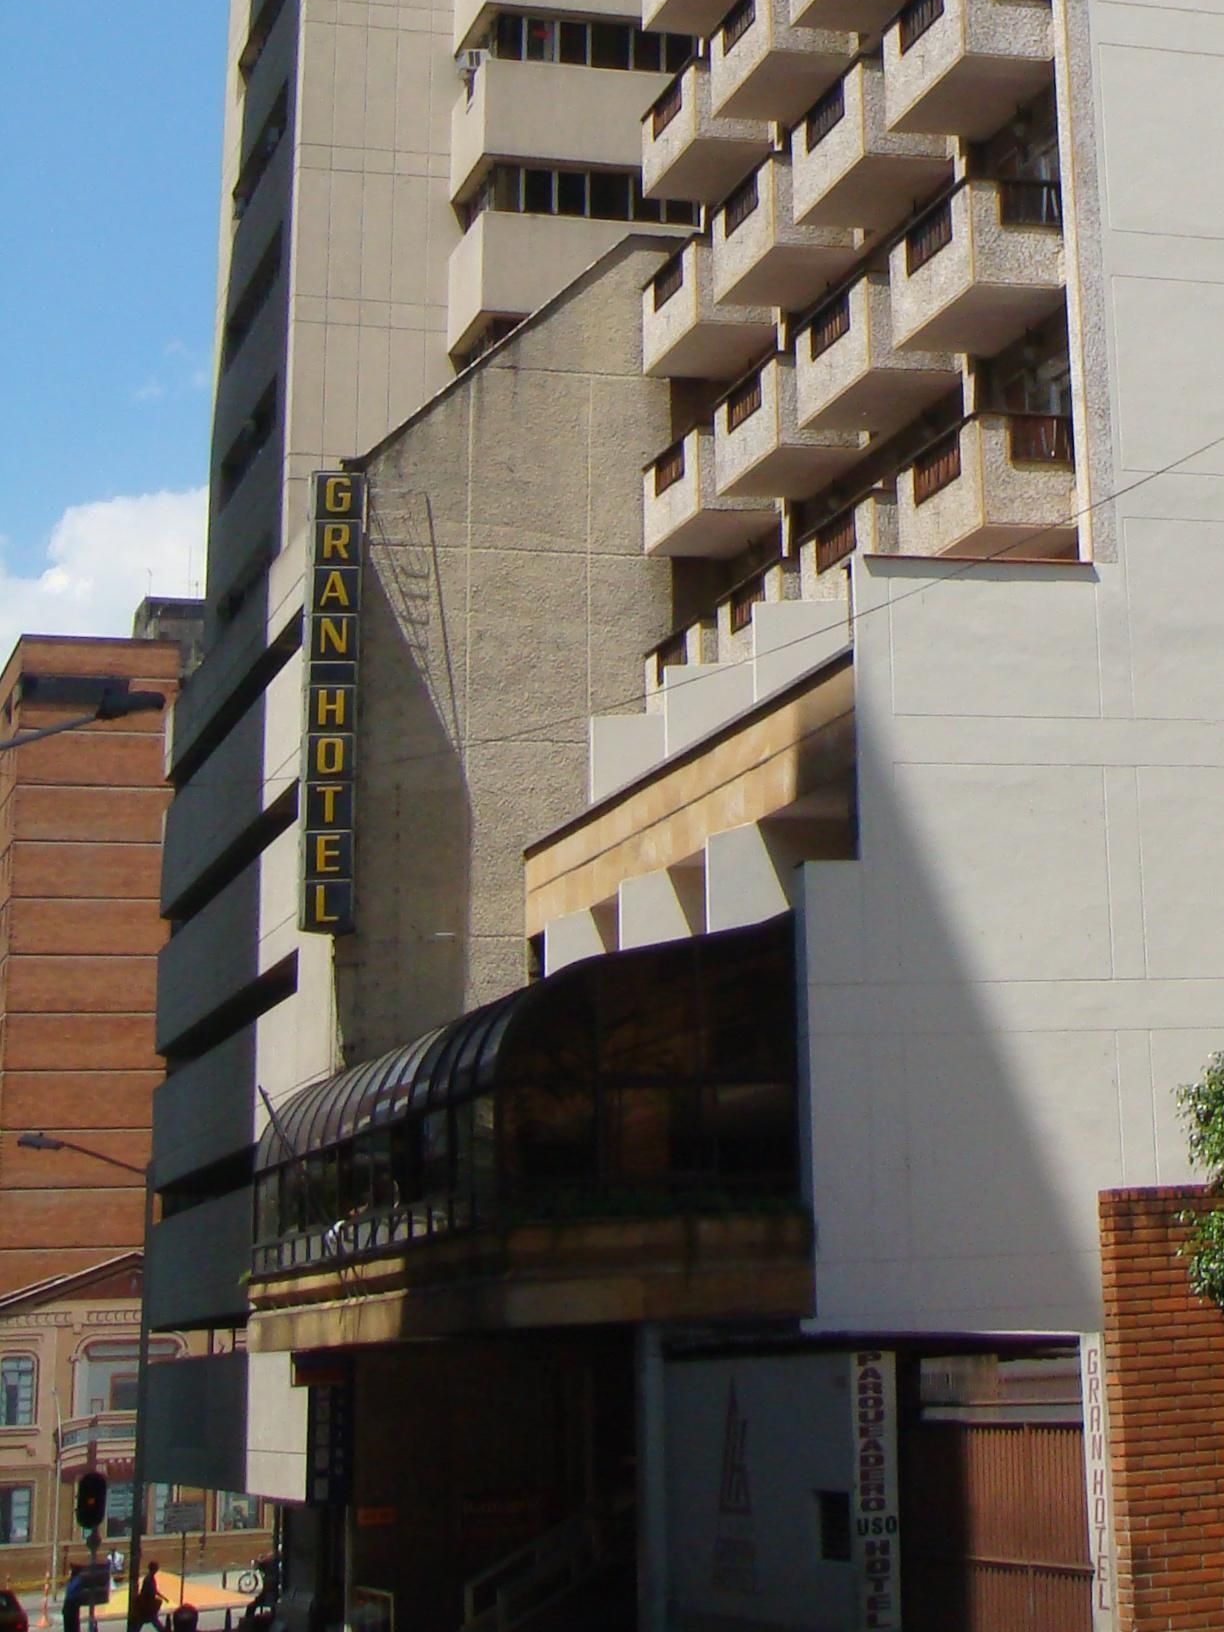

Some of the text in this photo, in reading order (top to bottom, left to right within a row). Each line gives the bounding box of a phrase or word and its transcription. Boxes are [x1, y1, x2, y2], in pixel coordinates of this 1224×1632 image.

[315, 476, 351, 924] GRAN HOTEL
[857, 1350, 886, 1512] PARQUEADERO
[1087, 1347, 1110, 1611] GRAN HOTEL
[856, 1515, 897, 1536] USO
[864, 1539, 892, 1630] HOTEL
